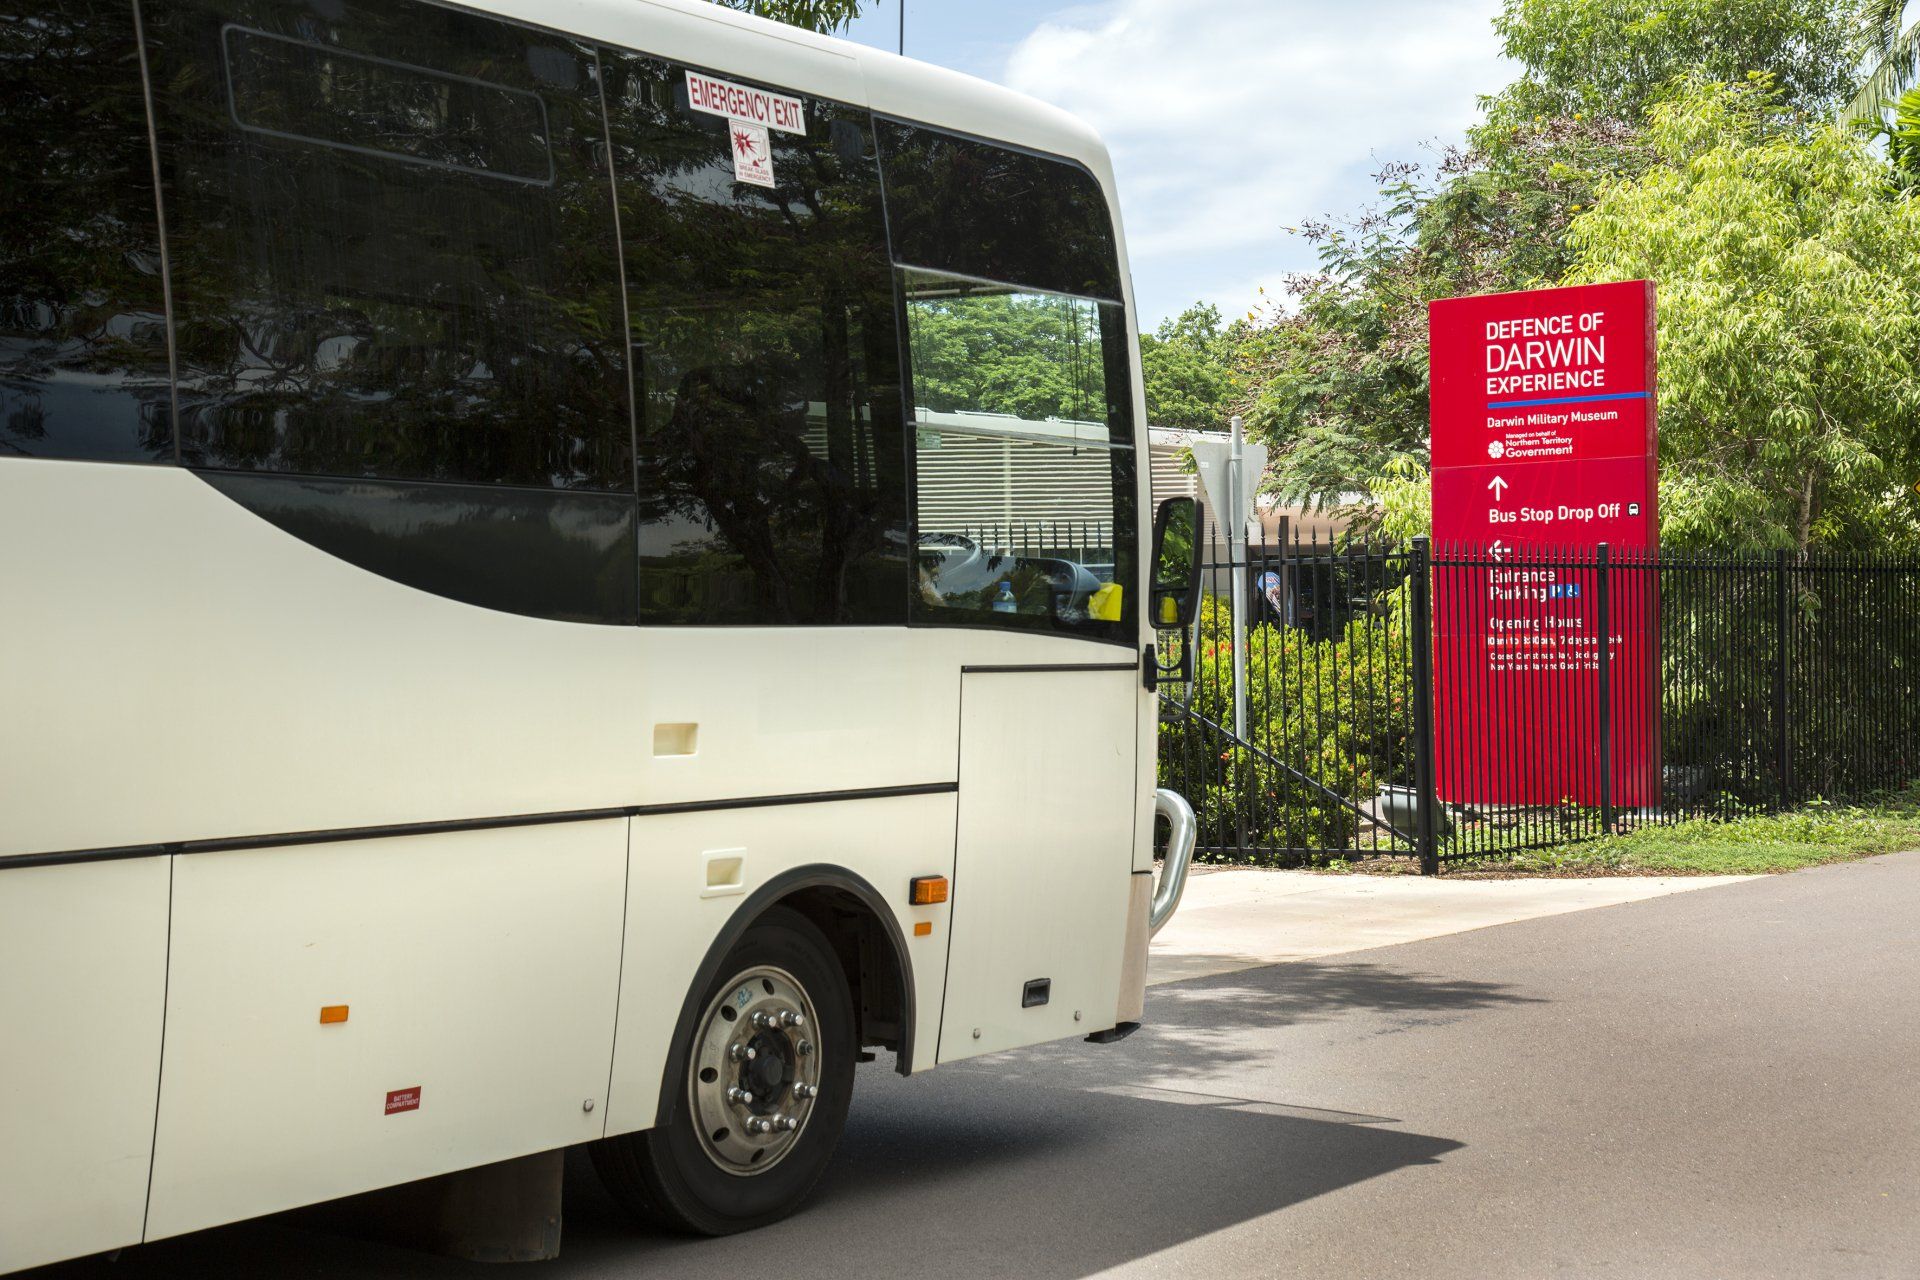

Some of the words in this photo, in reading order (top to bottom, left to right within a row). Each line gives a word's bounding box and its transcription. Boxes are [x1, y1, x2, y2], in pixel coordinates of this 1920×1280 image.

[690, 77, 771, 122] EMERGENCY
[773, 98, 800, 129] EXIT
[1486, 315, 1573, 340] DEFENCE
[1579, 312, 1604, 332] OF
[1486, 335, 1605, 373] DARWIN
[1486, 369, 1605, 395] EXPERIENCE
[1487, 416, 1525, 428] Darwin
[1527, 413, 1568, 426] Military
[1571, 411, 1618, 422] Museum
[1505, 438, 1540, 447] Northern
[1541, 436, 1573, 445] Territory
[1505, 445, 1573, 458] Government
[1489, 509, 1517, 523] Bus
[1520, 507, 1553, 525] Stop
[1558, 505, 1594, 523] Drop
[1598, 503, 1620, 518] Off
[1489, 569, 1556, 583] Entrance
[1490, 585, 1547, 603] Parking
[1560, 635, 1566, 645] 7
[1568, 635, 1590, 647] days
[1591, 637, 1597, 645] a
[1490, 652, 1513, 660] Cosed
[1516, 651, 1554, 660] Chrstmas
[386, 1098, 419, 1109] COMPARTMENT
[393, 1093, 413, 1102] BATTERY
